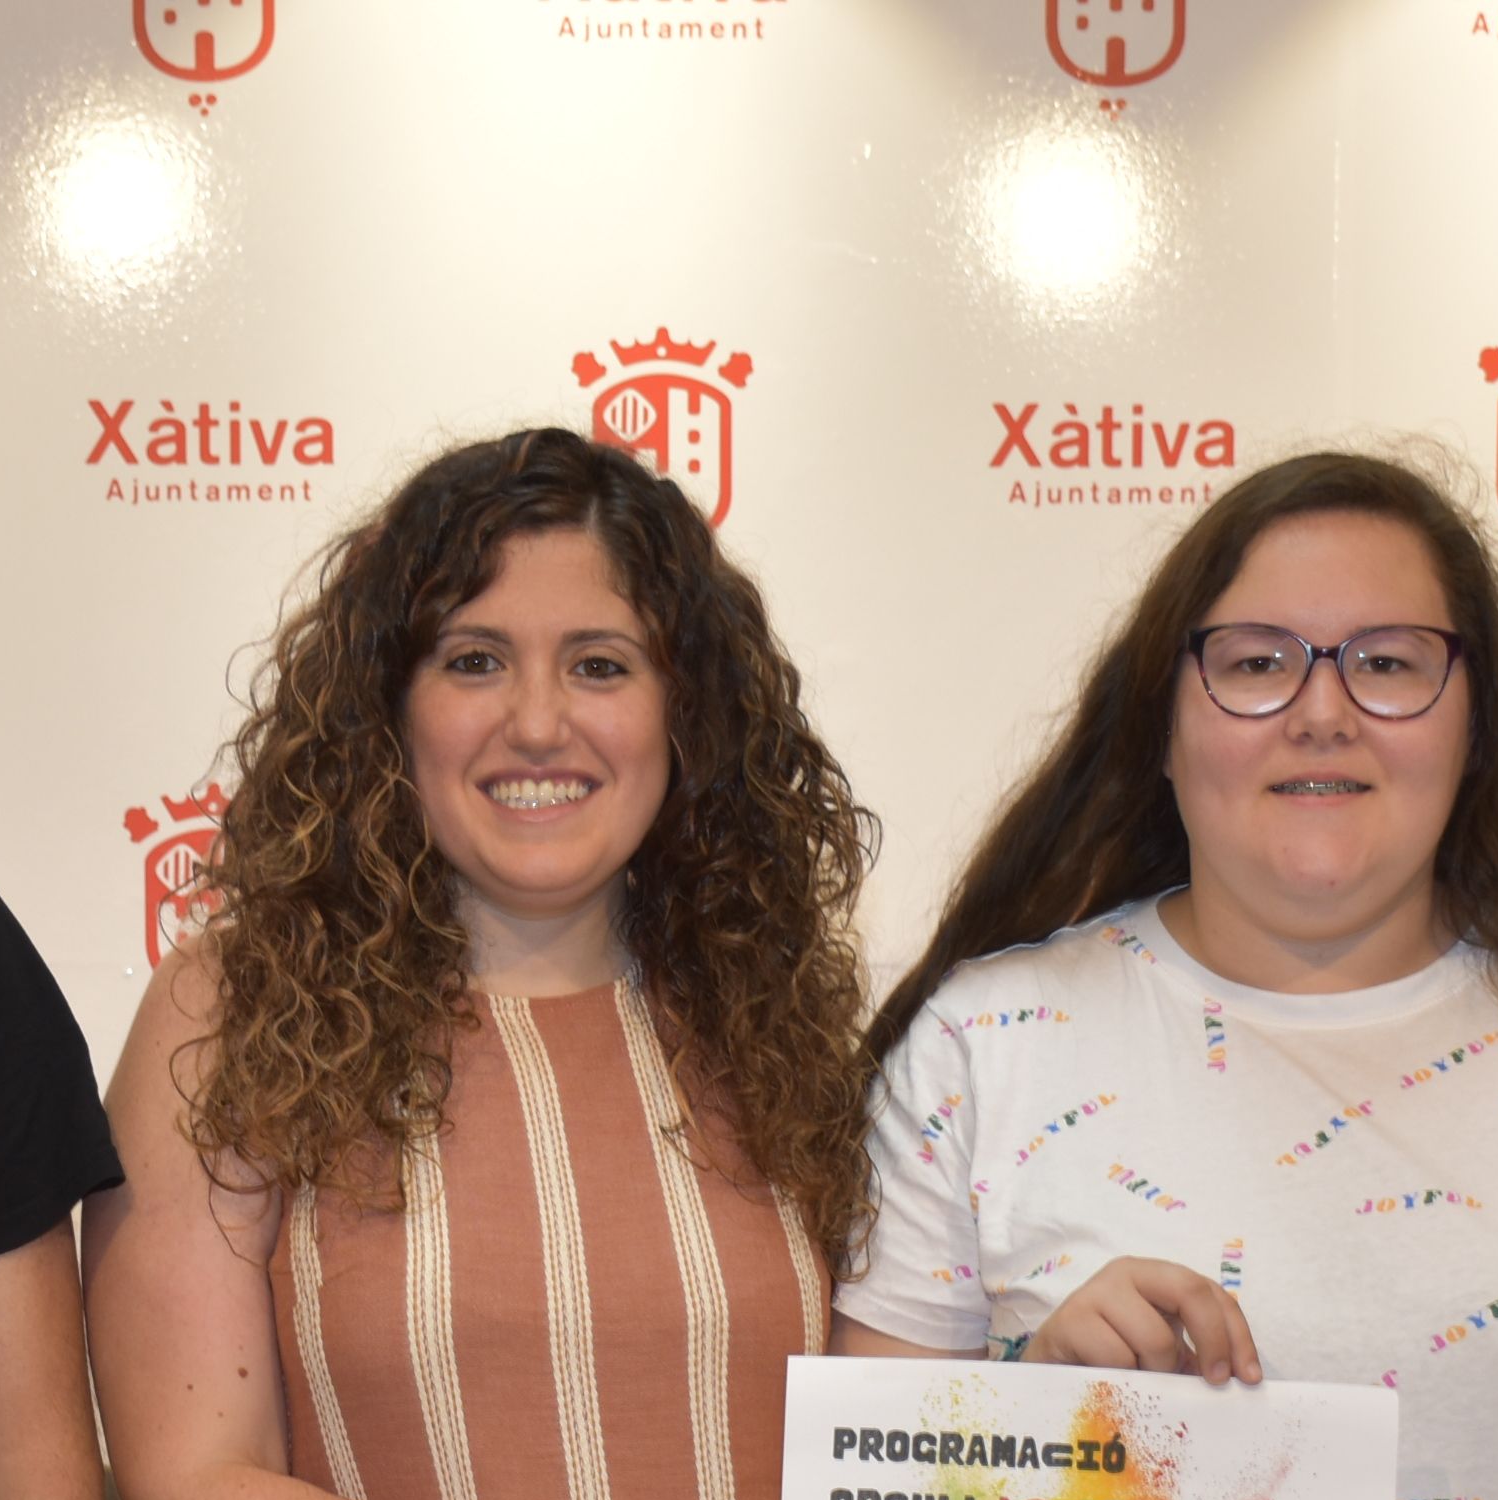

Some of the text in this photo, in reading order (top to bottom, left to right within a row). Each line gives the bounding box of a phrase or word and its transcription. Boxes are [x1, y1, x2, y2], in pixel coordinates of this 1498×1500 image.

[558, 16, 764, 42] Ajuntament
[85, 399, 334, 466] Xàtiva
[989, 403, 1235, 469] Xàtiva
[106, 478, 312, 506] Ajuntament
[1009, 481, 1213, 508] Ajuntament
[1016, 1094, 1116, 1165] JOYFUL
[1277, 1101, 1373, 1167] JOYFUL
[1108, 1163, 1186, 1211] JOYFUL
[1355, 1189, 1482, 1215] JOYFUL
[833, 1426, 1126, 1474] PROGRAMACIÓ
